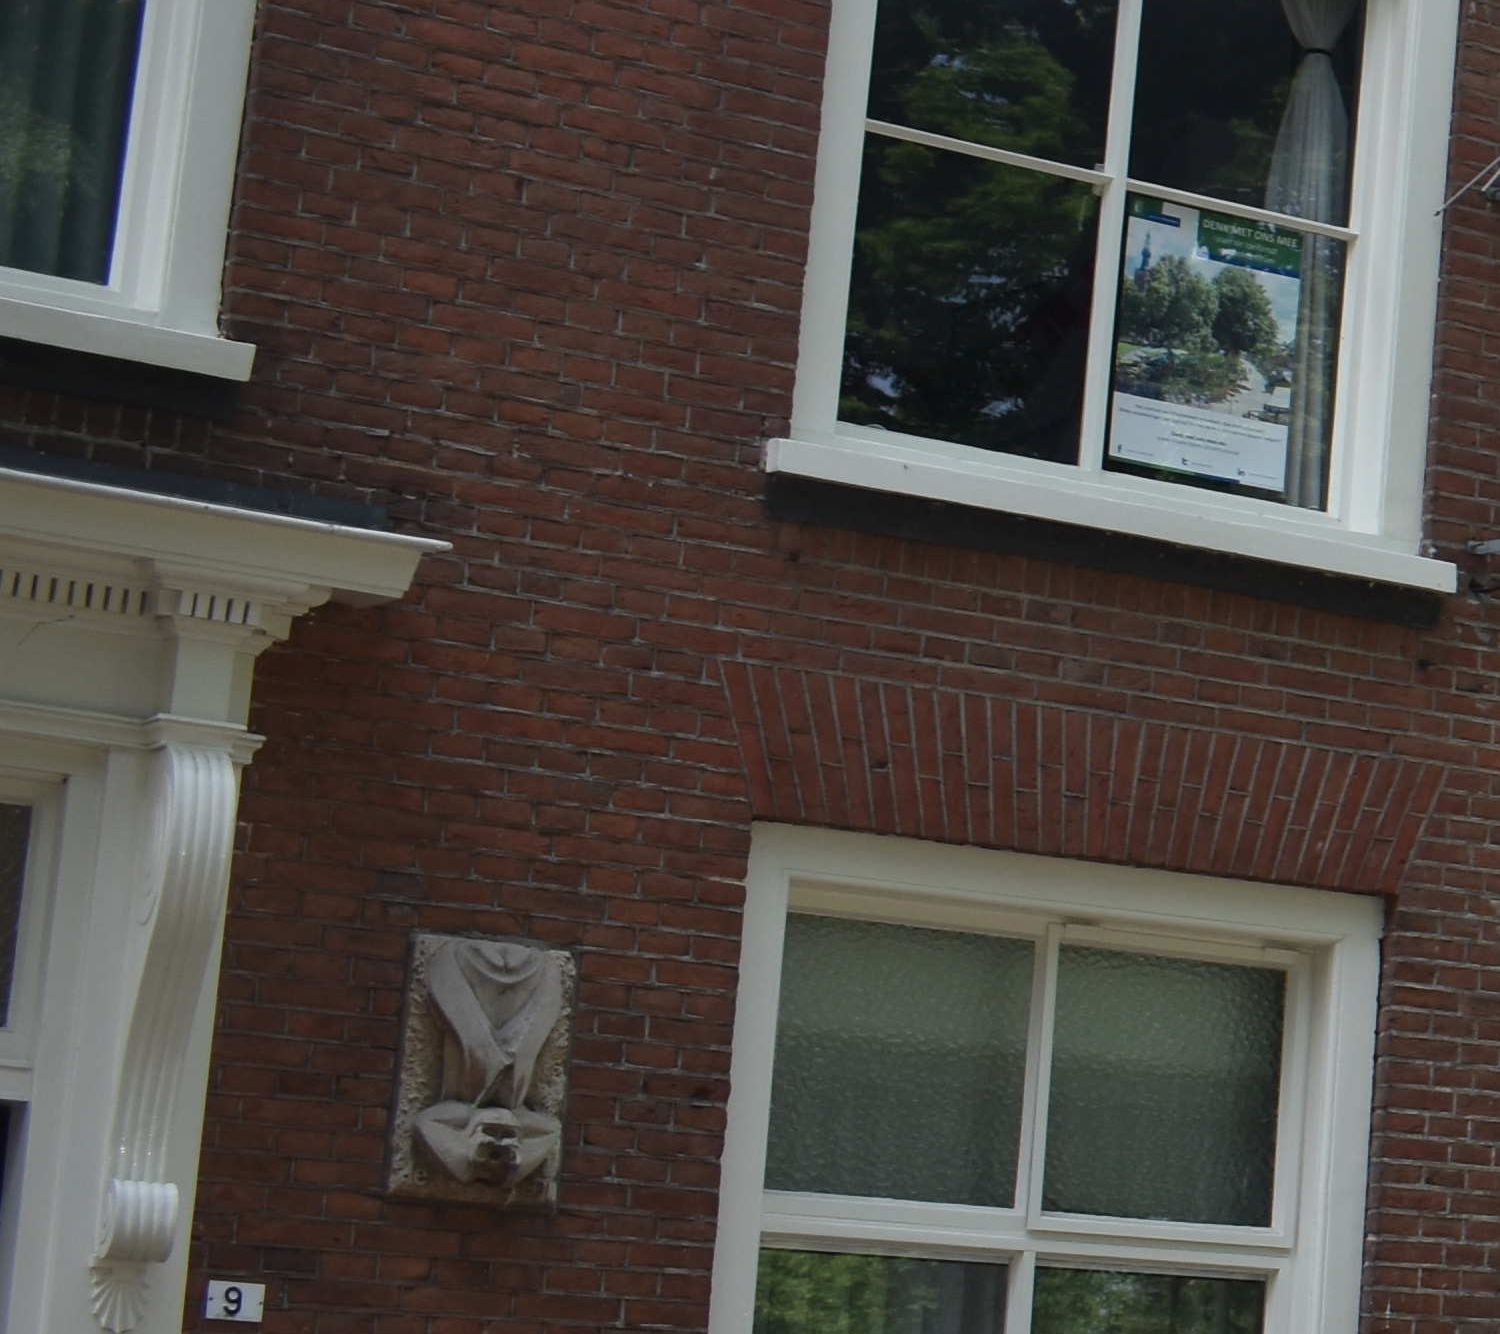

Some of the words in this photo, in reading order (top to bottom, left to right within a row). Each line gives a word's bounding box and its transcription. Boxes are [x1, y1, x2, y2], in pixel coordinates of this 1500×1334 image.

[1203, 218, 1230, 234] DENK
[1254, 230, 1275, 243] ONS
[1276, 235, 1298, 248] MEE
[223, 1286, 242, 1316] 9
